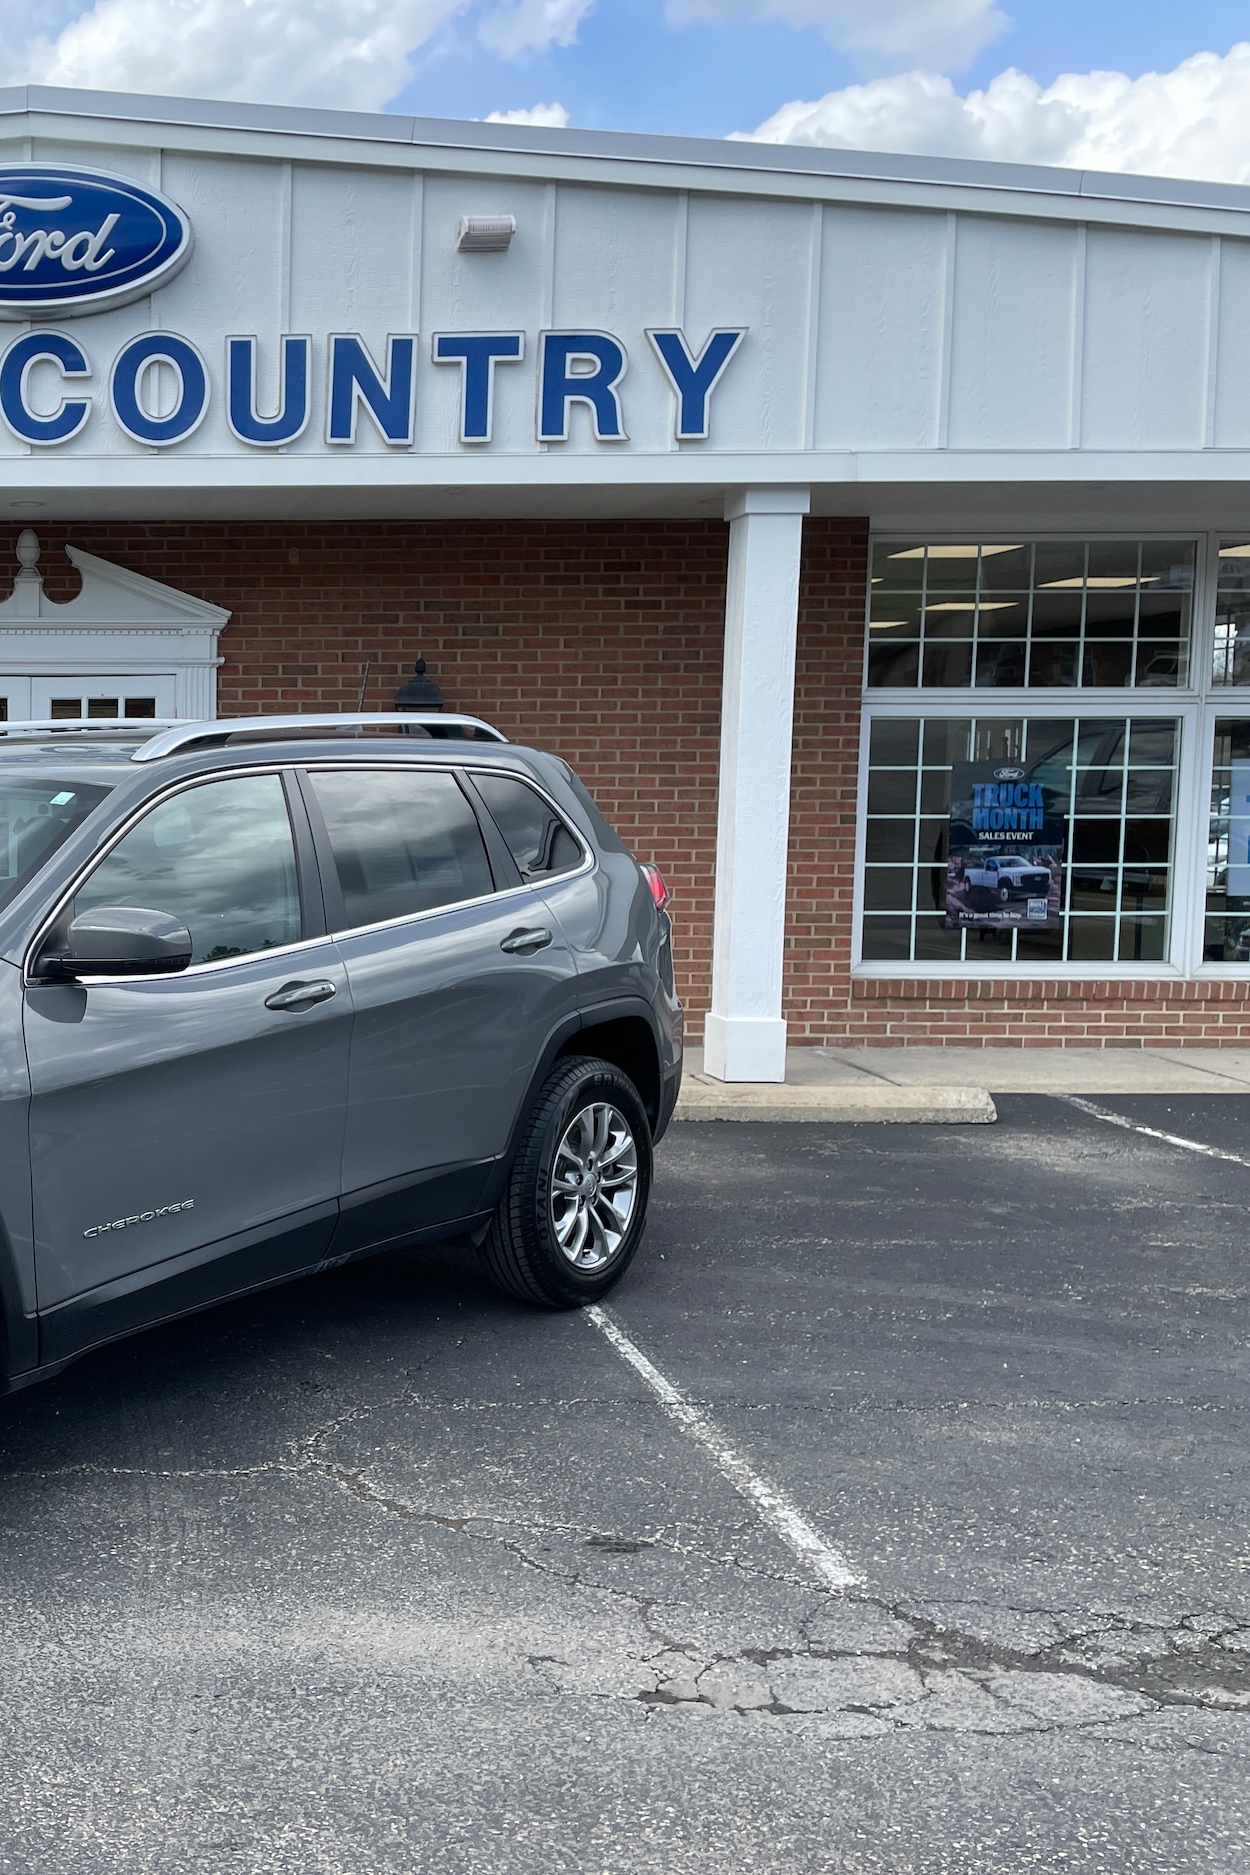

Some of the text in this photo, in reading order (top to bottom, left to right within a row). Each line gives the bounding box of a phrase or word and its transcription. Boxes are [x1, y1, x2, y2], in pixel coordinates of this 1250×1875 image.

[972, 783, 1044, 806] TRUCK
[972, 808, 1044, 829] MONTH
[979, 832, 1034, 840] SALES EVENT
[83, 1199, 195, 1238] CHEROKEE
